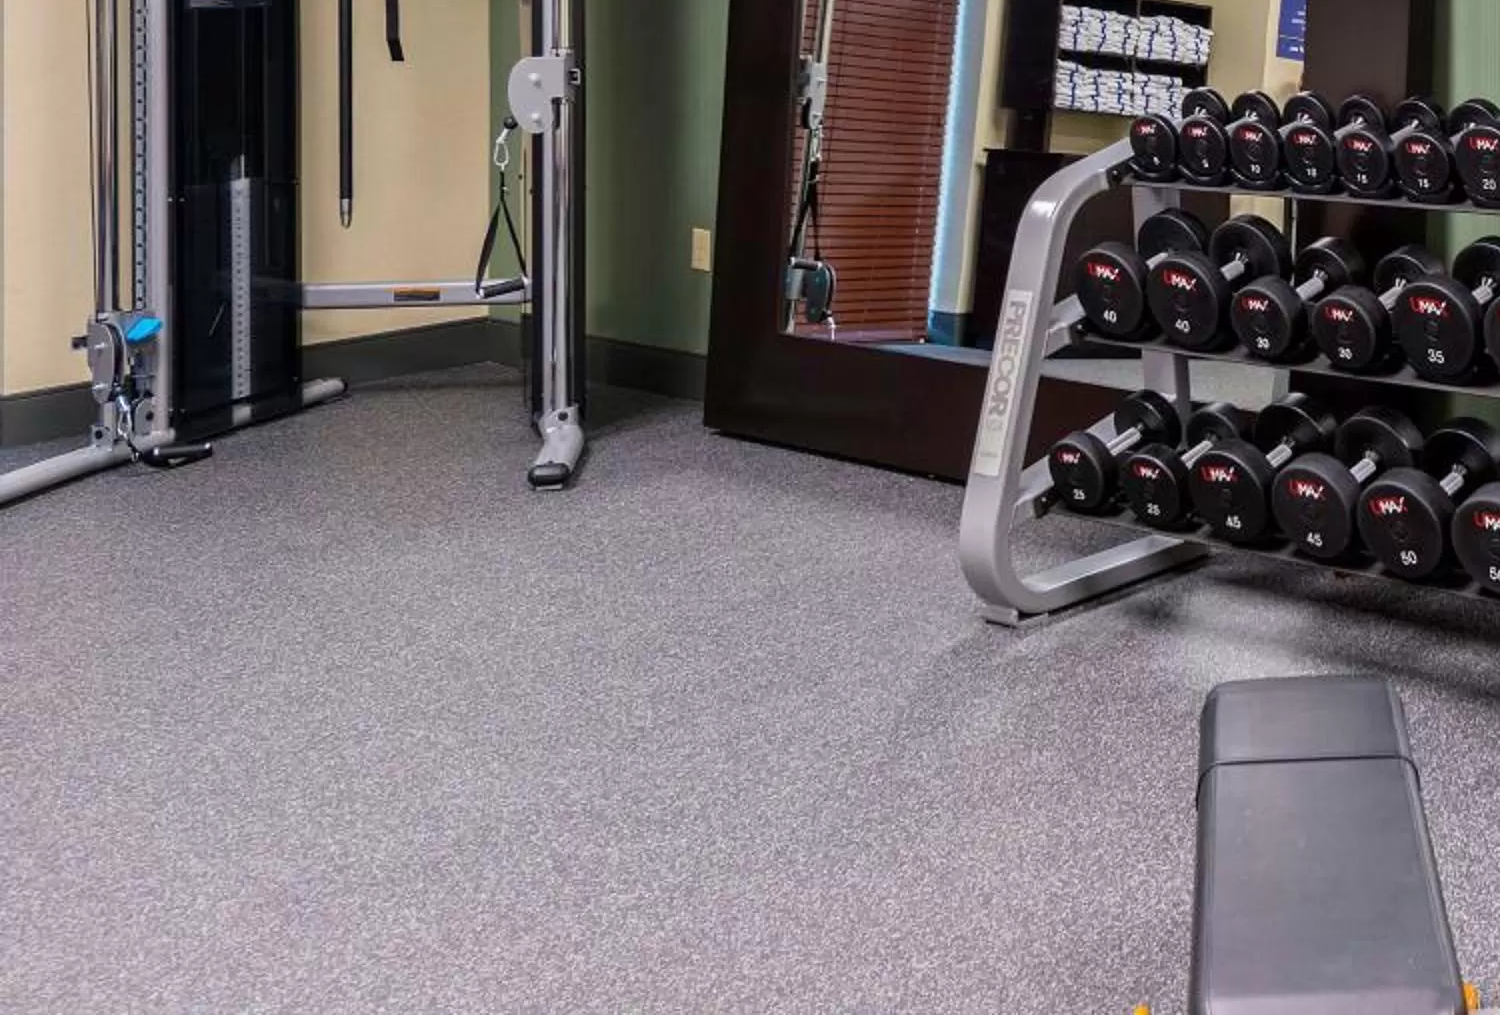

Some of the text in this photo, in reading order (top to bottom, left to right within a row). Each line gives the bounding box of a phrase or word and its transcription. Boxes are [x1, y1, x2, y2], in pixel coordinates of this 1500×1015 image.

[1356, 173, 1368, 184] 15
[1417, 178, 1429, 189] 15
[1482, 179, 1496, 191] 20
[1408, 296, 1448, 317] UMAX
[1103, 310, 1117, 323] 40
[1175, 319, 1190, 333] 40
[988, 300, 1027, 417] PRECOR
[1427, 348, 1445, 364] 35
[1073, 488, 1085, 501] 25
[1146, 502, 1160, 516] 25
[1368, 496, 1408, 515] UMAX
[1226, 515, 1242, 529] 45
[1307, 532, 1323, 547] 45
[1400, 550, 1417, 566] 50
